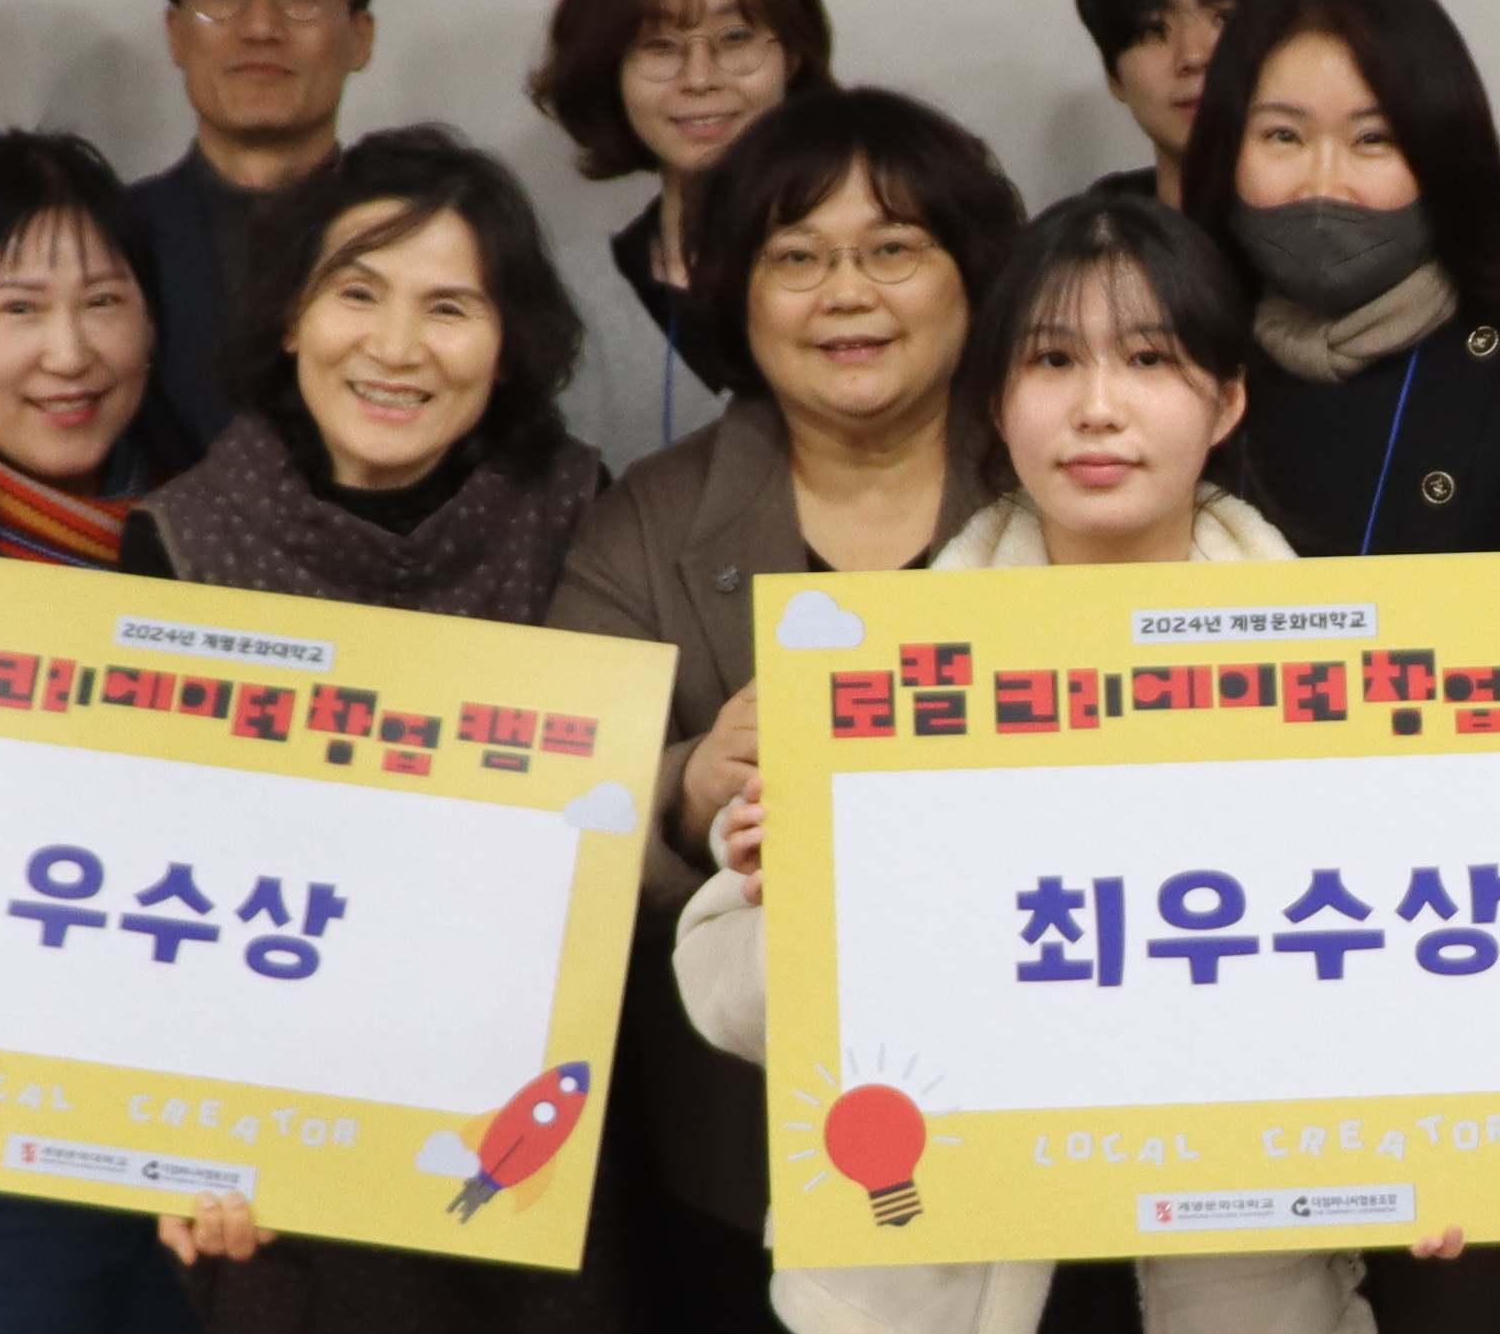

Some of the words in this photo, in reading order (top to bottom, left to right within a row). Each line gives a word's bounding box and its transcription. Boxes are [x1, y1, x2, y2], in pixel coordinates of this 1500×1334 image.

[120, 622, 196, 647] 2024년
[200, 631, 325, 664] 계명문화대학교
[1140, 614, 1222, 635] 2024년
[1230, 610, 1368, 633] 계명문화대학교
[6, 842, 348, 980] 우수상
[127, 1092, 359, 1148] CREATOR
[1032, 1130, 1201, 1167] LOCAL
